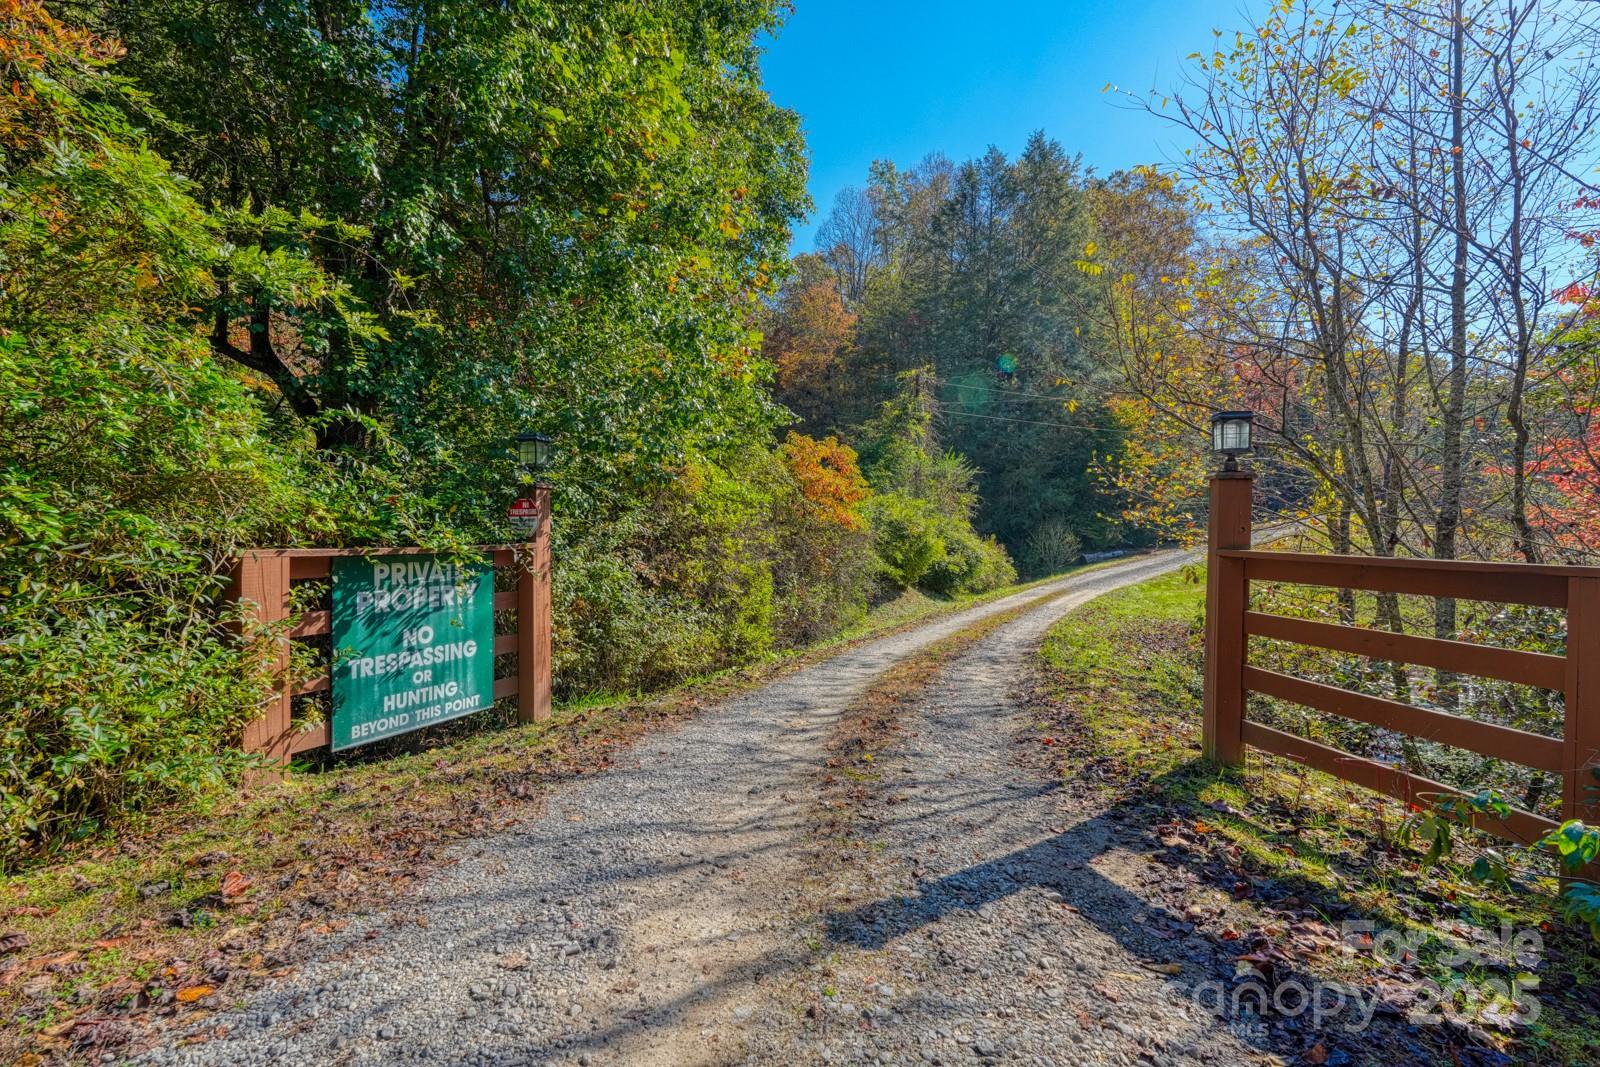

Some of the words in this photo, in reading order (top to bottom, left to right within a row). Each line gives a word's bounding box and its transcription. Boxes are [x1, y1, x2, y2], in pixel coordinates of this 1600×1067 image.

[356, 583, 478, 616] PROPERTY
[402, 625, 434, 647] NO
[348, 640, 478, 680] TRESPASSING
[412, 669, 432, 684] OR
[383, 681, 458, 713] HUNTING
[351, 713, 410, 740] BEYOND
[415, 705, 441, 722] THIS
[445, 695, 480, 713] POINT
